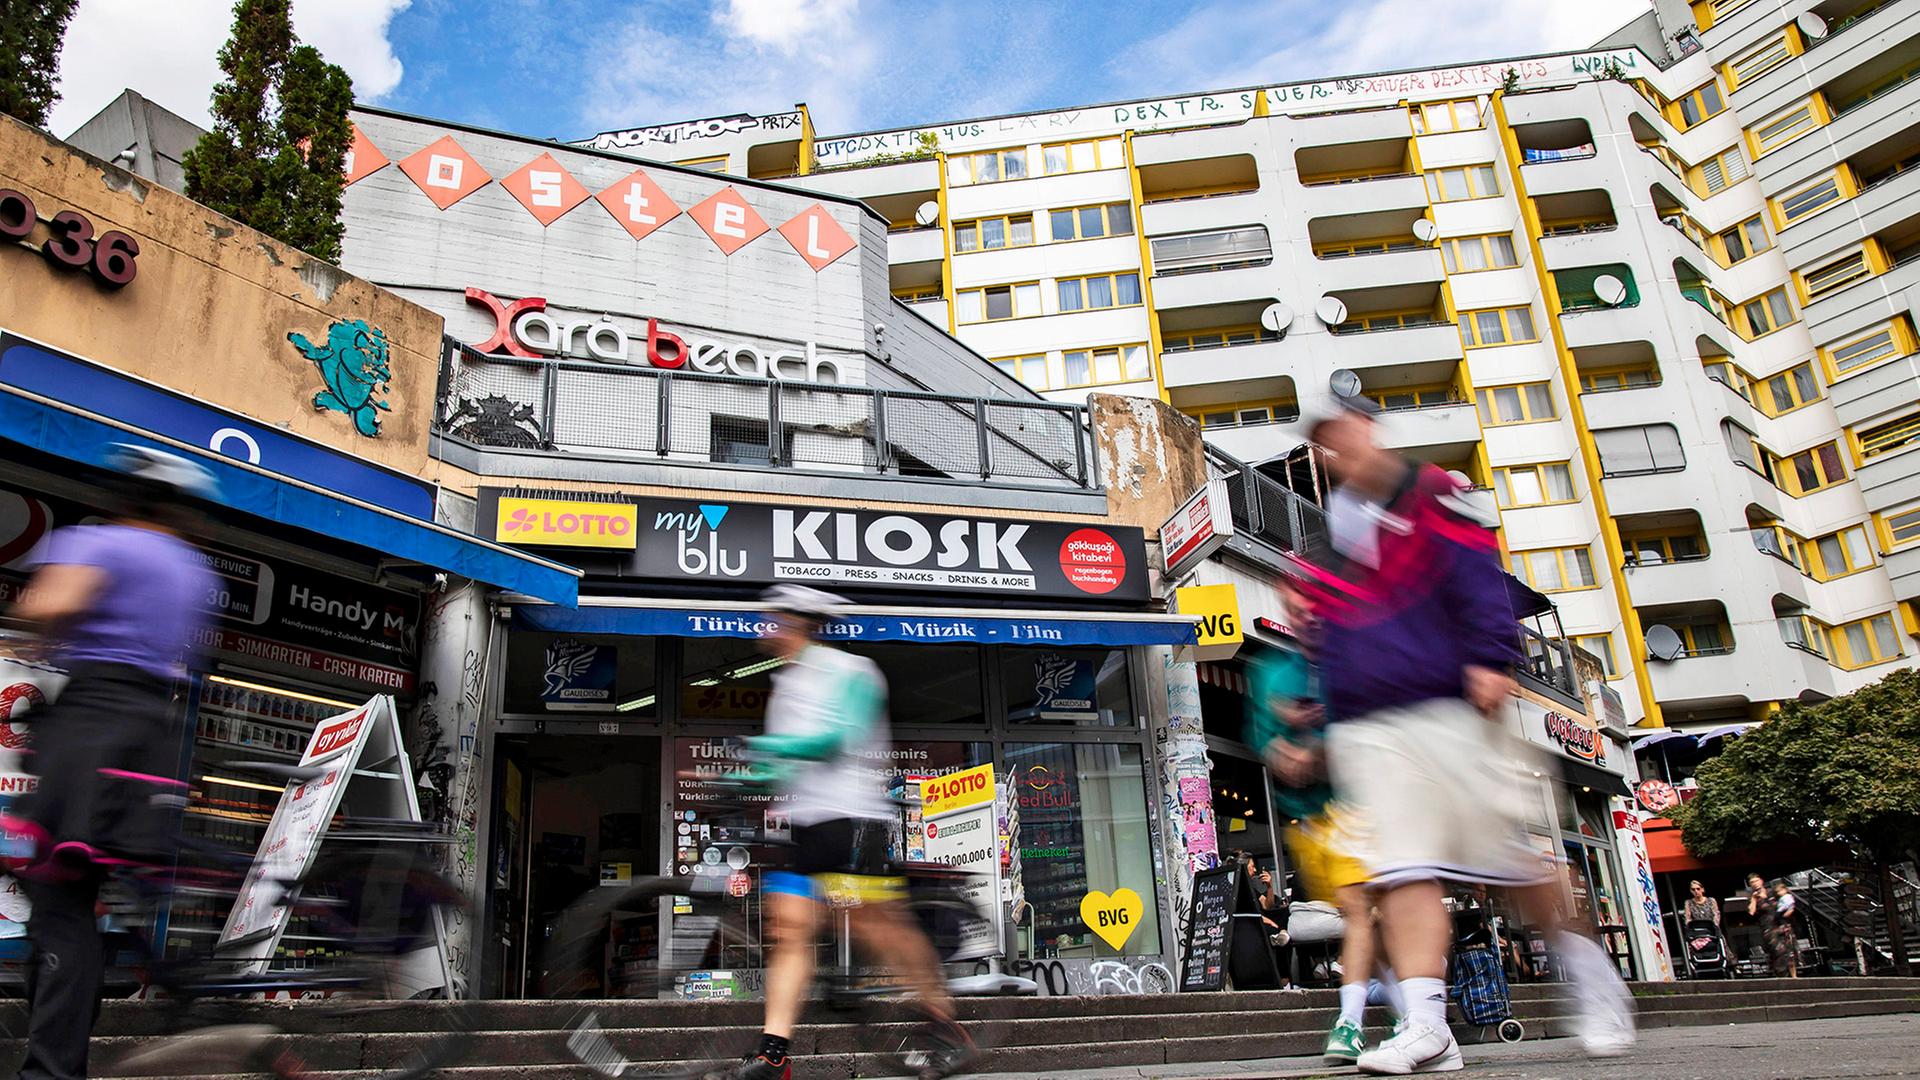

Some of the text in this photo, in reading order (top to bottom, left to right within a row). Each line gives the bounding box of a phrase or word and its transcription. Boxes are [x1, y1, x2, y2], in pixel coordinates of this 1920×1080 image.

[42, 209, 140, 289] 36
[646, 317, 845, 385] beach
[542, 510, 631, 537] LOTTO
[653, 510, 748, 577] my blu
[773, 508, 1034, 571] KIOSK
[1072, 552, 1112, 563] kitabevi
[779, 565, 1031, 587] TOBACCO PRESS SNACKS DRINKS & MORE
[205, 587, 231, 608] 30
[289, 584, 378, 631] Handy
[281, 616, 334, 636] Handyverträge
[688, 615, 779, 638] Türkçe
[900, 621, 977, 638] Müzik
[236, 637, 311, 668] SIMKARTEN
[323, 656, 356, 679] CASH
[359, 665, 404, 689] KARTEN
[864, 747, 929, 760] ouvenirs
[773, 792, 791, 802] auf
[942, 772, 987, 800] LOTTO
[1043, 789, 1073, 808] Bull
[986, 847, 993, 859] €
[1021, 846, 1070, 859] Heineken
[1097, 907, 1129, 928] BVG
